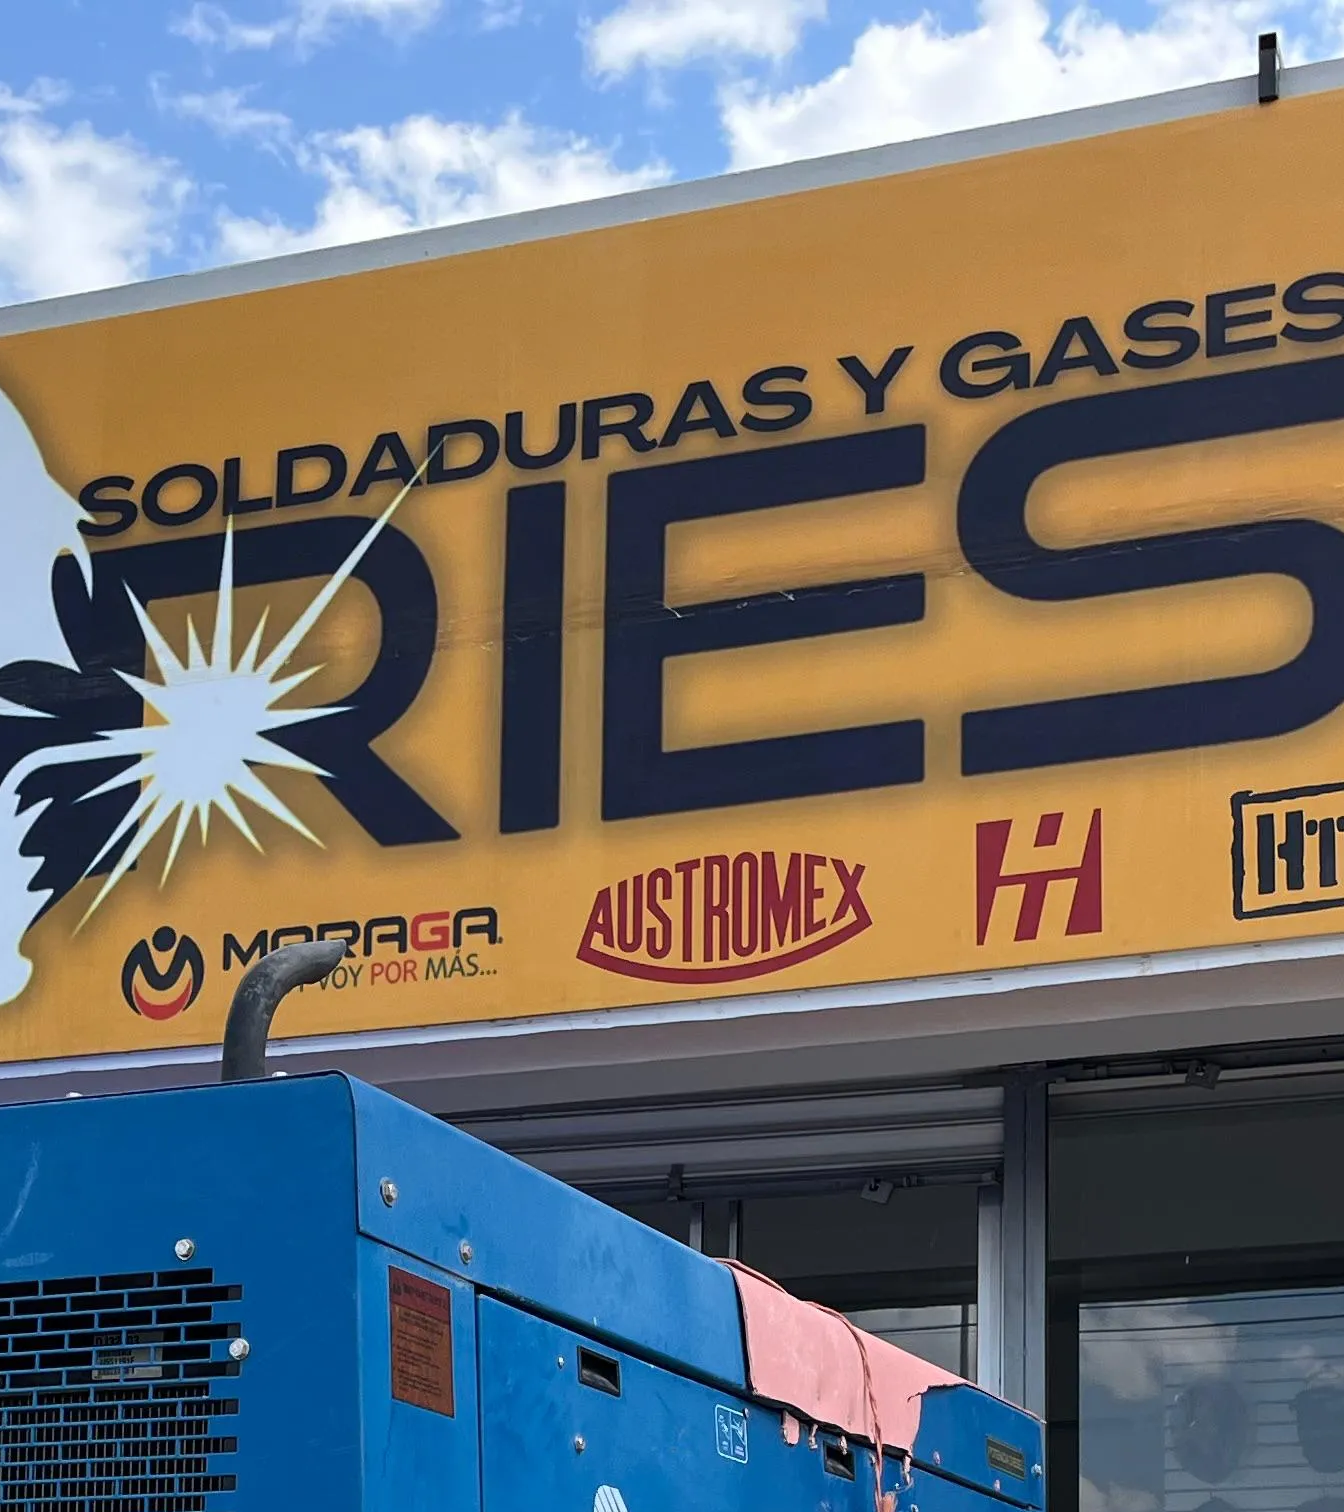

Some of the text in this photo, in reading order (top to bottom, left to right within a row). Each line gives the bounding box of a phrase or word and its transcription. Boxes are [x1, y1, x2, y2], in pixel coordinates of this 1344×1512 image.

[76, 365, 814, 537] SOLDADURAS
[836, 345, 915, 416] Y
[222, 906, 498, 972] MORAGA
[584, 850, 868, 966] AUSTROMEX
[370, 958, 418, 986] POR
[424, 949, 498, 981] MÁS...
